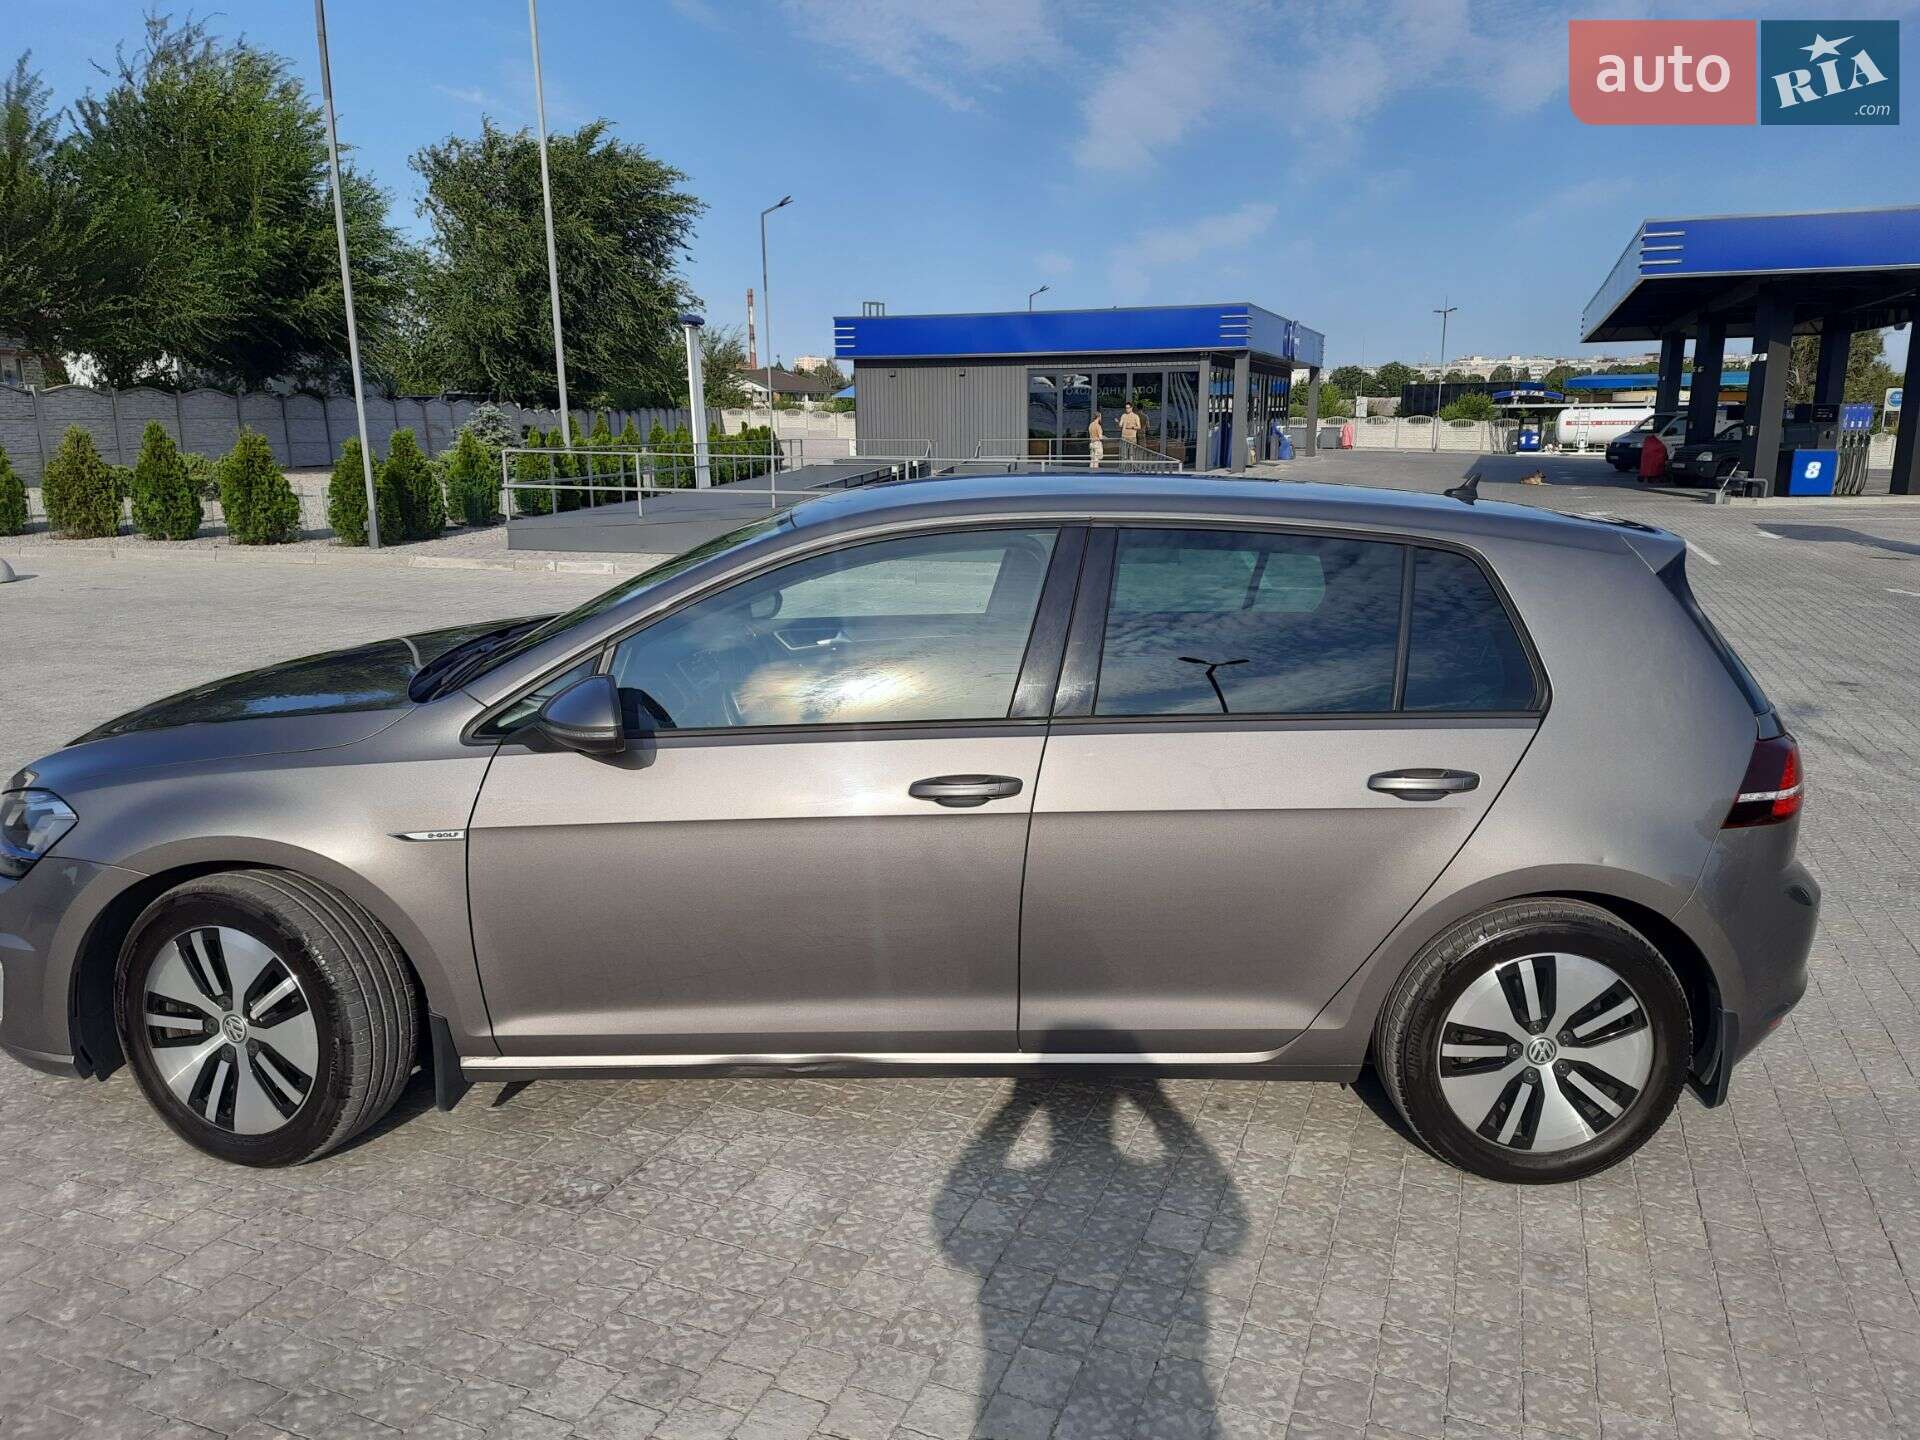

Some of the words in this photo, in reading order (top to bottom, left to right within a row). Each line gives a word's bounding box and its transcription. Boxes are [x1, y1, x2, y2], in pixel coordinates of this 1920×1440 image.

[1520, 436, 1526, 445] 1
[1530, 435, 1539, 445] 2
[1804, 461, 1822, 479] 8
